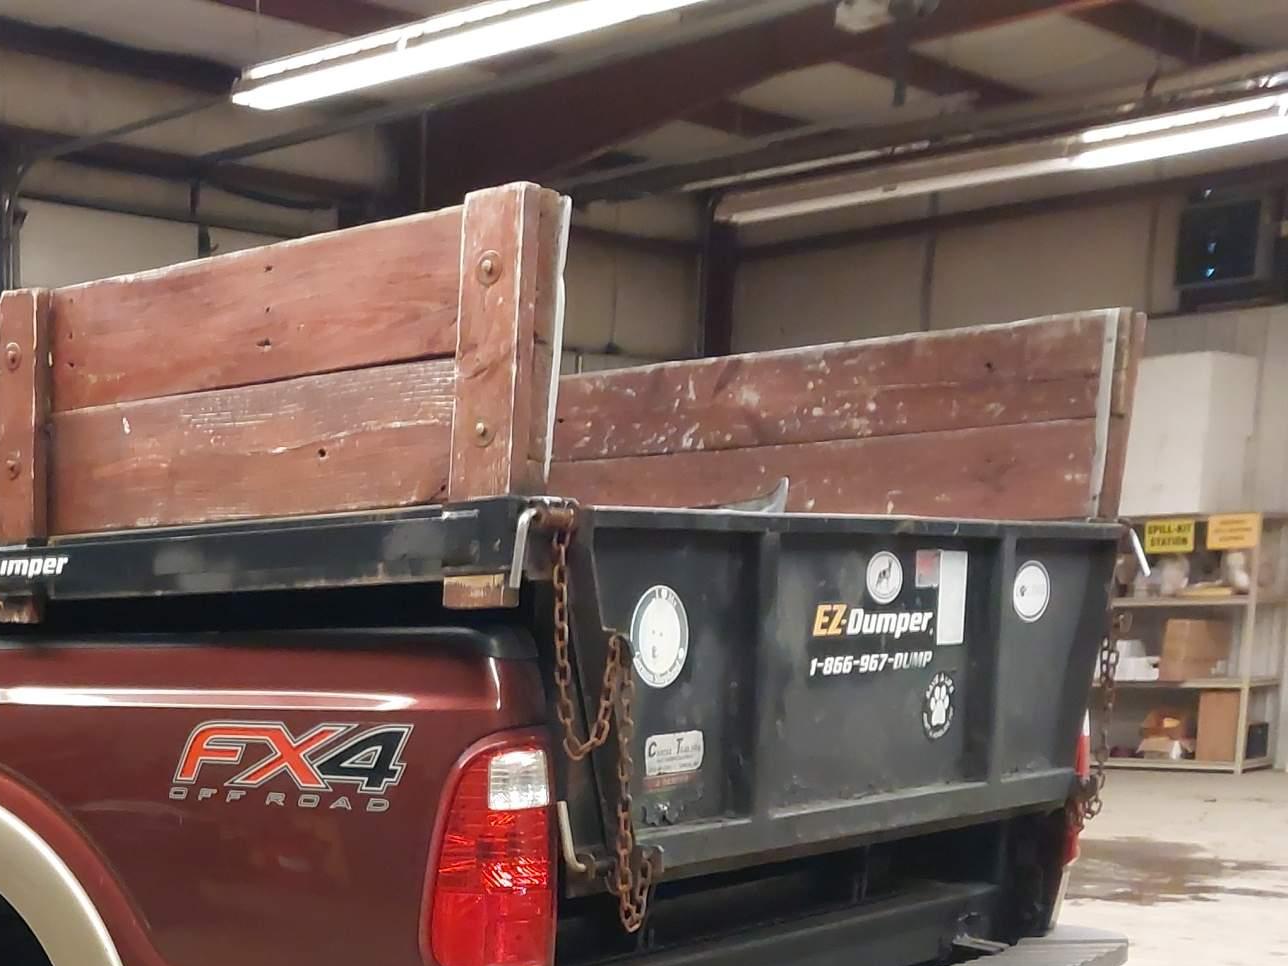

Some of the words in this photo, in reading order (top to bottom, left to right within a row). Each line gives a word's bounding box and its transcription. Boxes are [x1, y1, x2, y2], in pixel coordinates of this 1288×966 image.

[1147, 522, 1192, 535] SPILL-KIT
[1150, 536, 1188, 547] STATION
[813, 604, 933, 639] EZ-Dumper
[809, 651, 933, 676] 1-866-967-DUMP
[172, 720, 415, 794] FX4
[265, 791, 390, 812] ROAD
